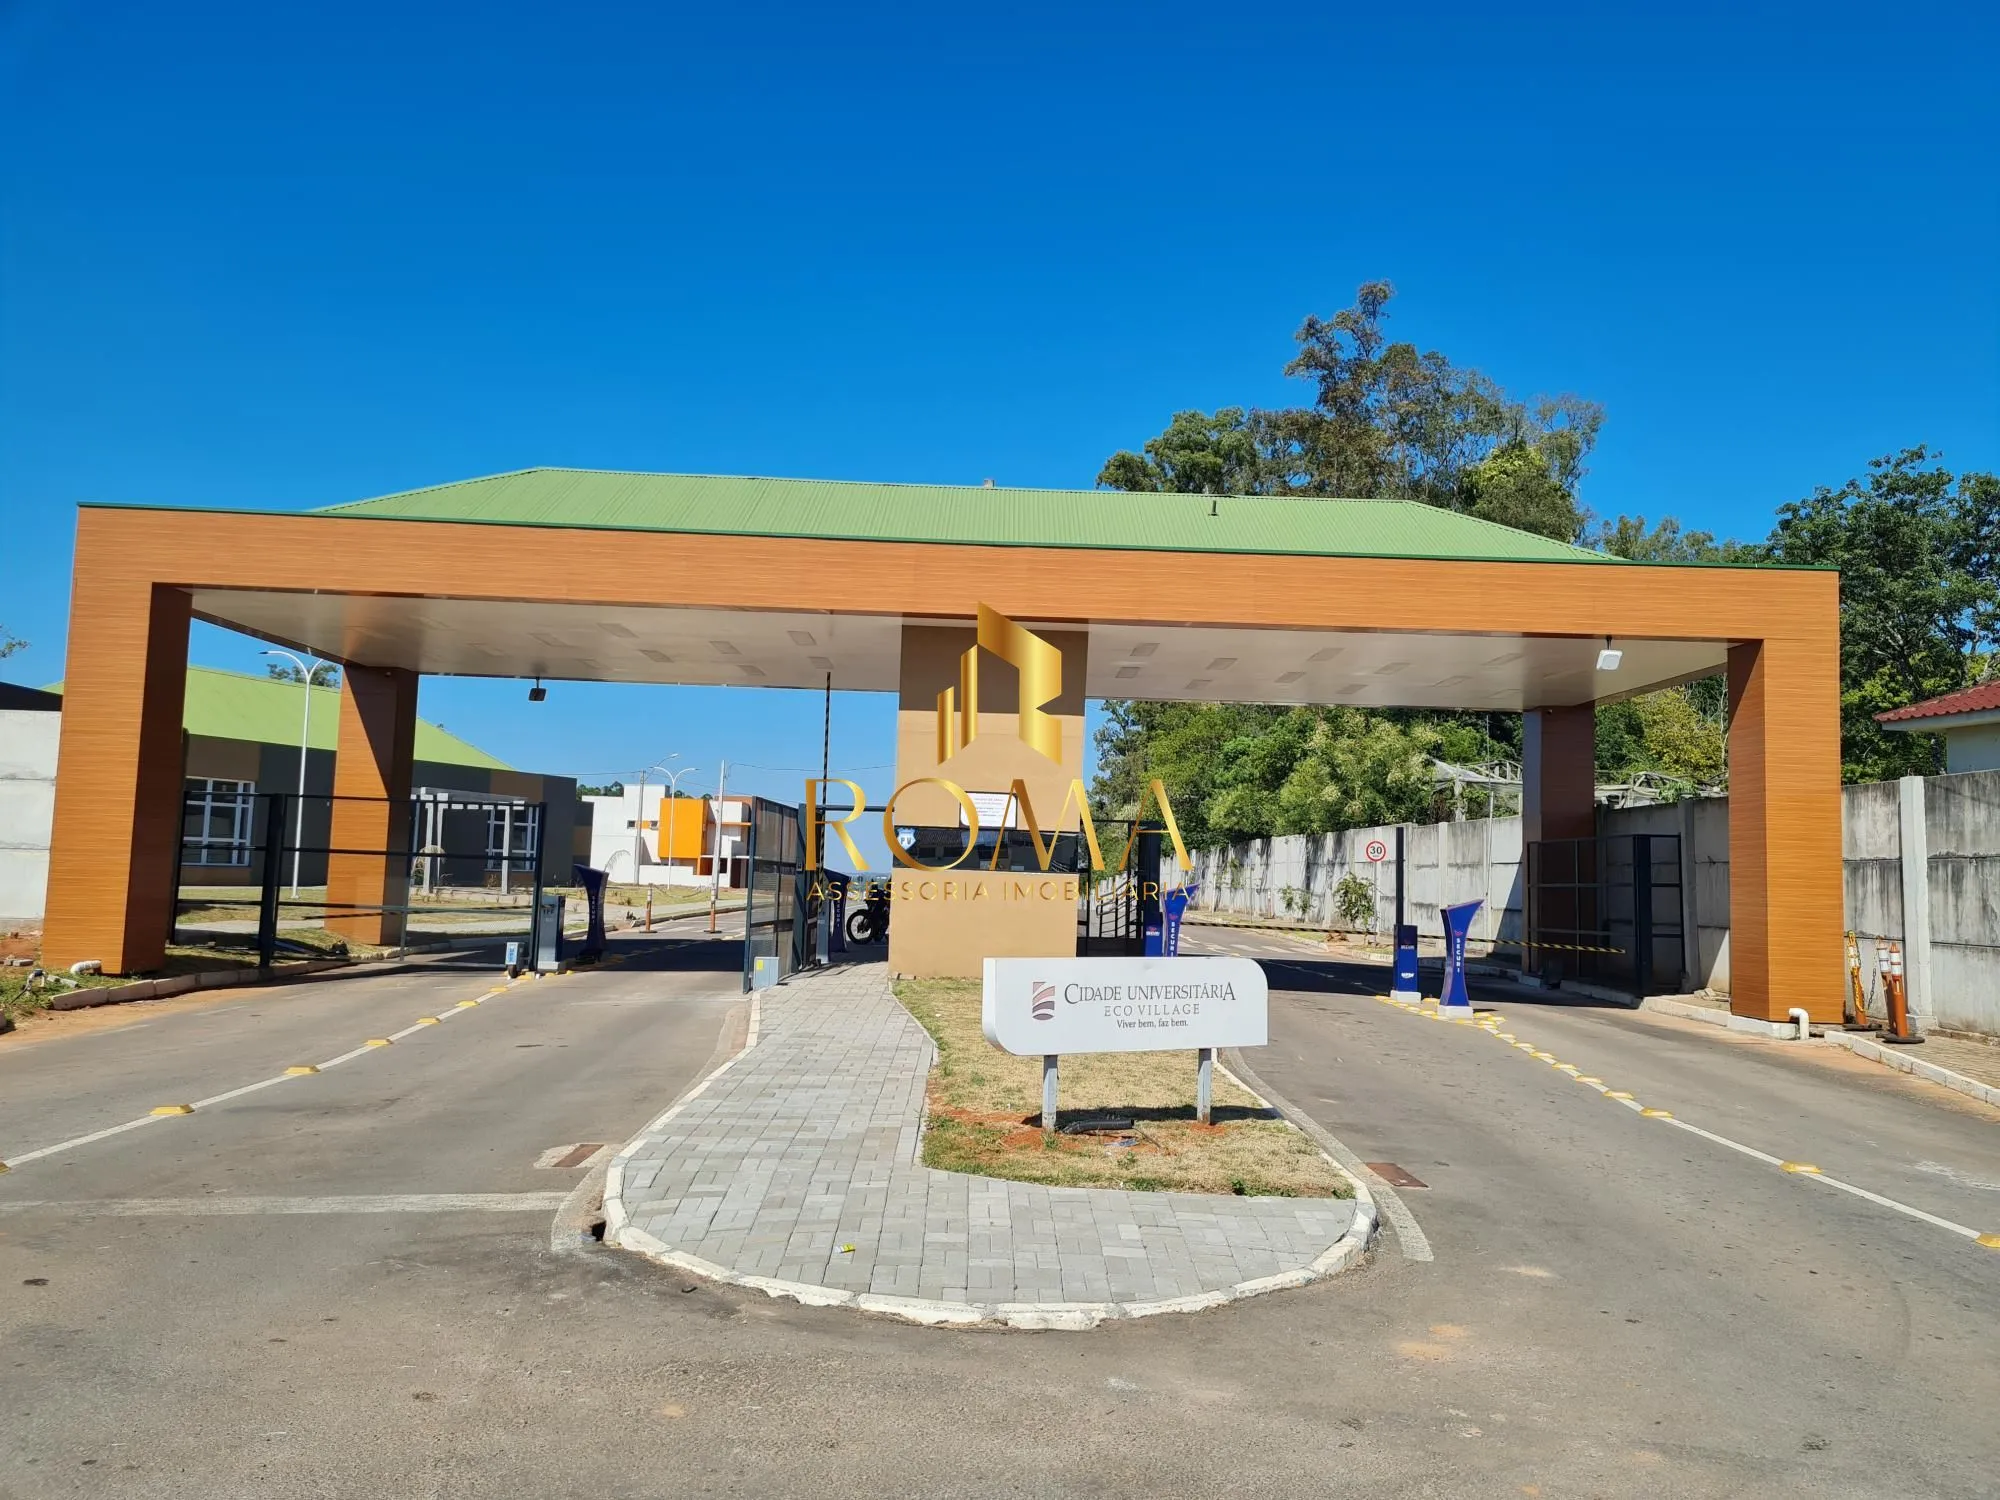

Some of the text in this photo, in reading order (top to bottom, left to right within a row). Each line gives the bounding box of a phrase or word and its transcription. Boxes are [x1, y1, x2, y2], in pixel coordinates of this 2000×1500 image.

[1370, 846, 1382, 855] 30
[1064, 982, 1236, 1004] CIDADE UNIVERSITÁRIA
[1104, 1003, 1200, 1017] ECO VILLAGE
[1117, 1018, 1189, 1029] Viver bem, faz bem.
